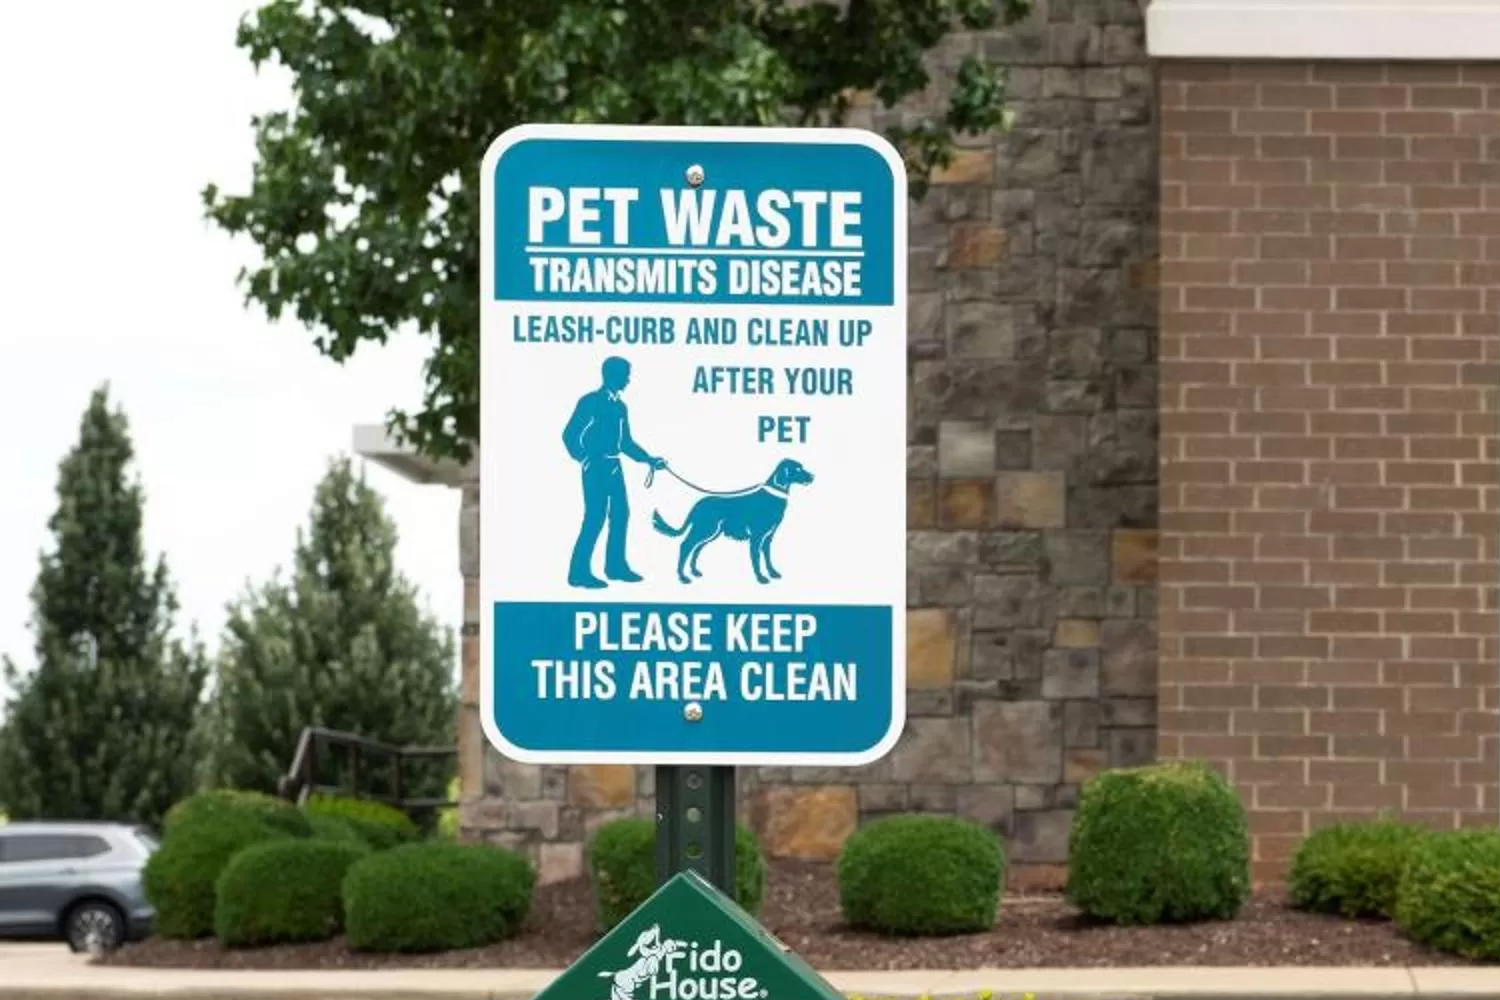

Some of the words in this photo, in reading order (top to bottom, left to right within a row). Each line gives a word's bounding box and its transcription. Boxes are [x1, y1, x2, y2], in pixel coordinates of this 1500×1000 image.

[528, 186, 639, 245] PET
[660, 187, 863, 249] WASTE
[529, 257, 717, 295] TRANSMITS
[728, 259, 862, 298] DISEASE
[513, 315, 675, 345] LEASH-CURB
[685, 317, 737, 345] AND
[747, 318, 829, 347] CLEAN
[839, 319, 873, 347] UP
[692, 366, 774, 395] AFTER
[784, 367, 853, 396] YOUR
[757, 415, 811, 443] PET
[574, 611, 712, 651] PLEASE
[725, 613, 817, 653] KEEP
[531, 660, 616, 699] THIS
[629, 661, 727, 700] AREA
[740, 662, 857, 701] CLEAN
[665, 939, 743, 973] Fido
